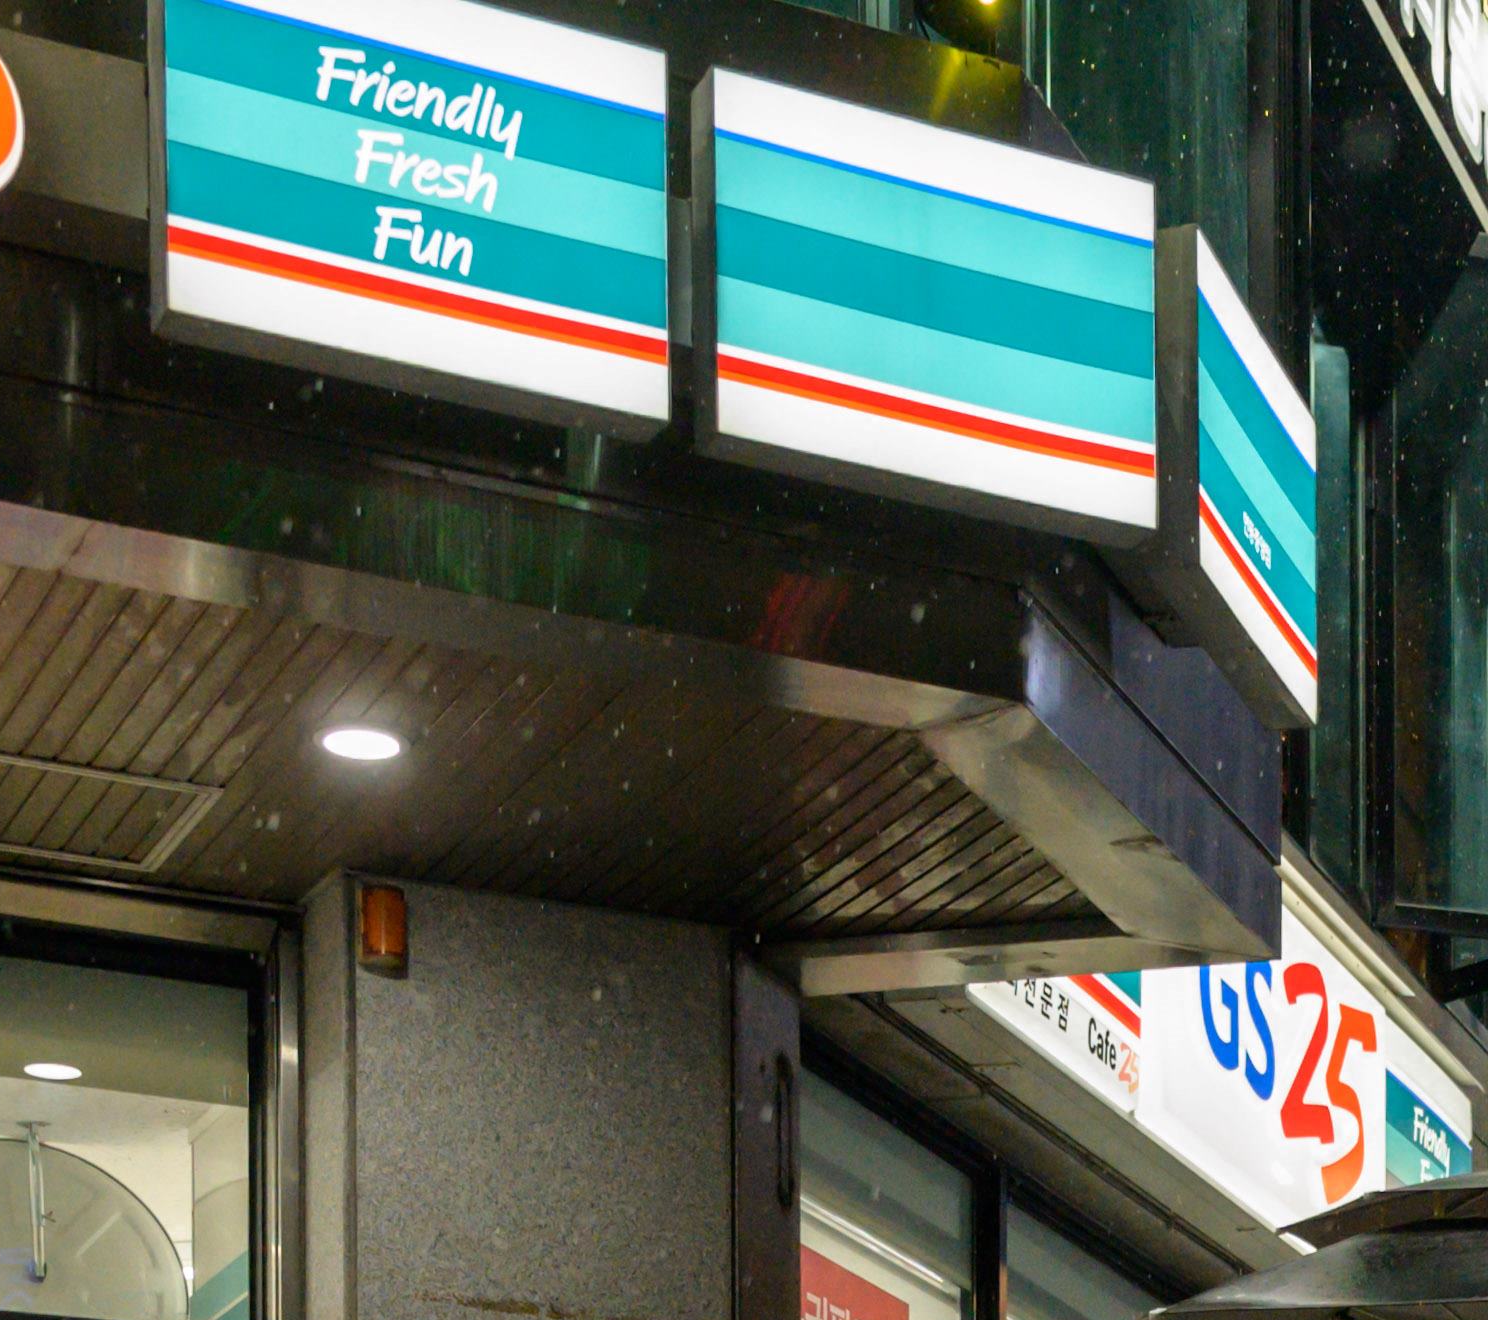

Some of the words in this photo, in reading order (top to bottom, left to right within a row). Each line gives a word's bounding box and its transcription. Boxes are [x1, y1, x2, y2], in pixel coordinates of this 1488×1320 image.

[314, 46, 522, 160] Friendly
[353, 131, 498, 214] Fresh
[373, 207, 473, 278] Fun
[1199, 960, 1377, 1204] GS25
